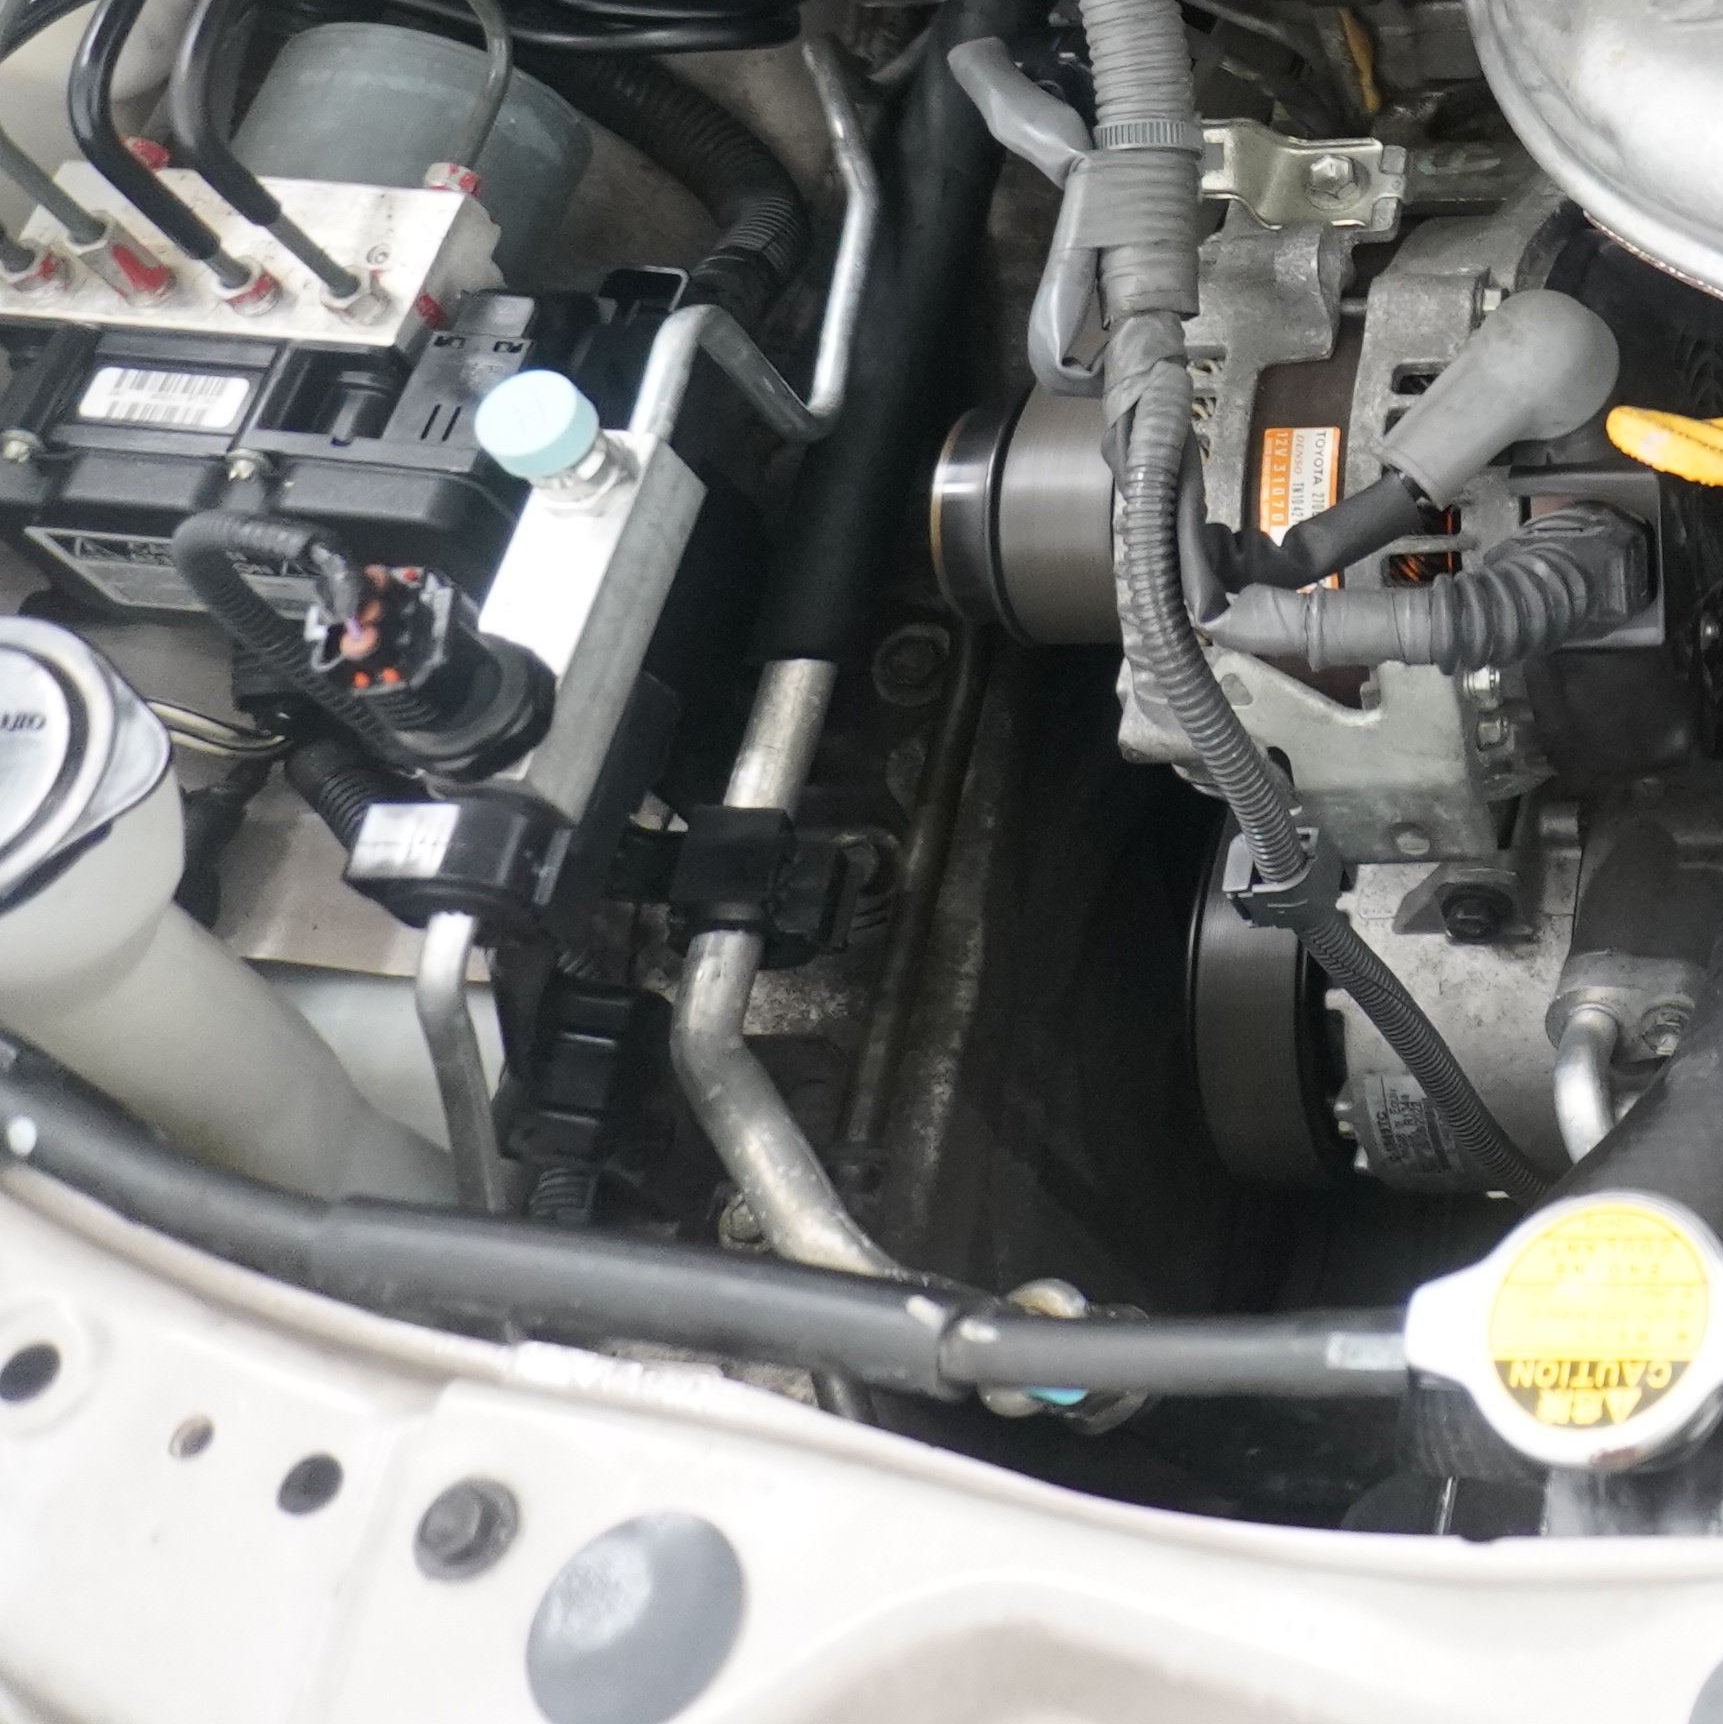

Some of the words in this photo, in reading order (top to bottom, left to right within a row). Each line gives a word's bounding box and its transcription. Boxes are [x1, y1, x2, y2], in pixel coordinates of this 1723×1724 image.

[1274, 432, 1289, 458] 12V
[1312, 430, 1327, 486] TOYOTA
[1290, 482, 1305, 523] TN1042
[1508, 1360, 1673, 1389] CAUTION
